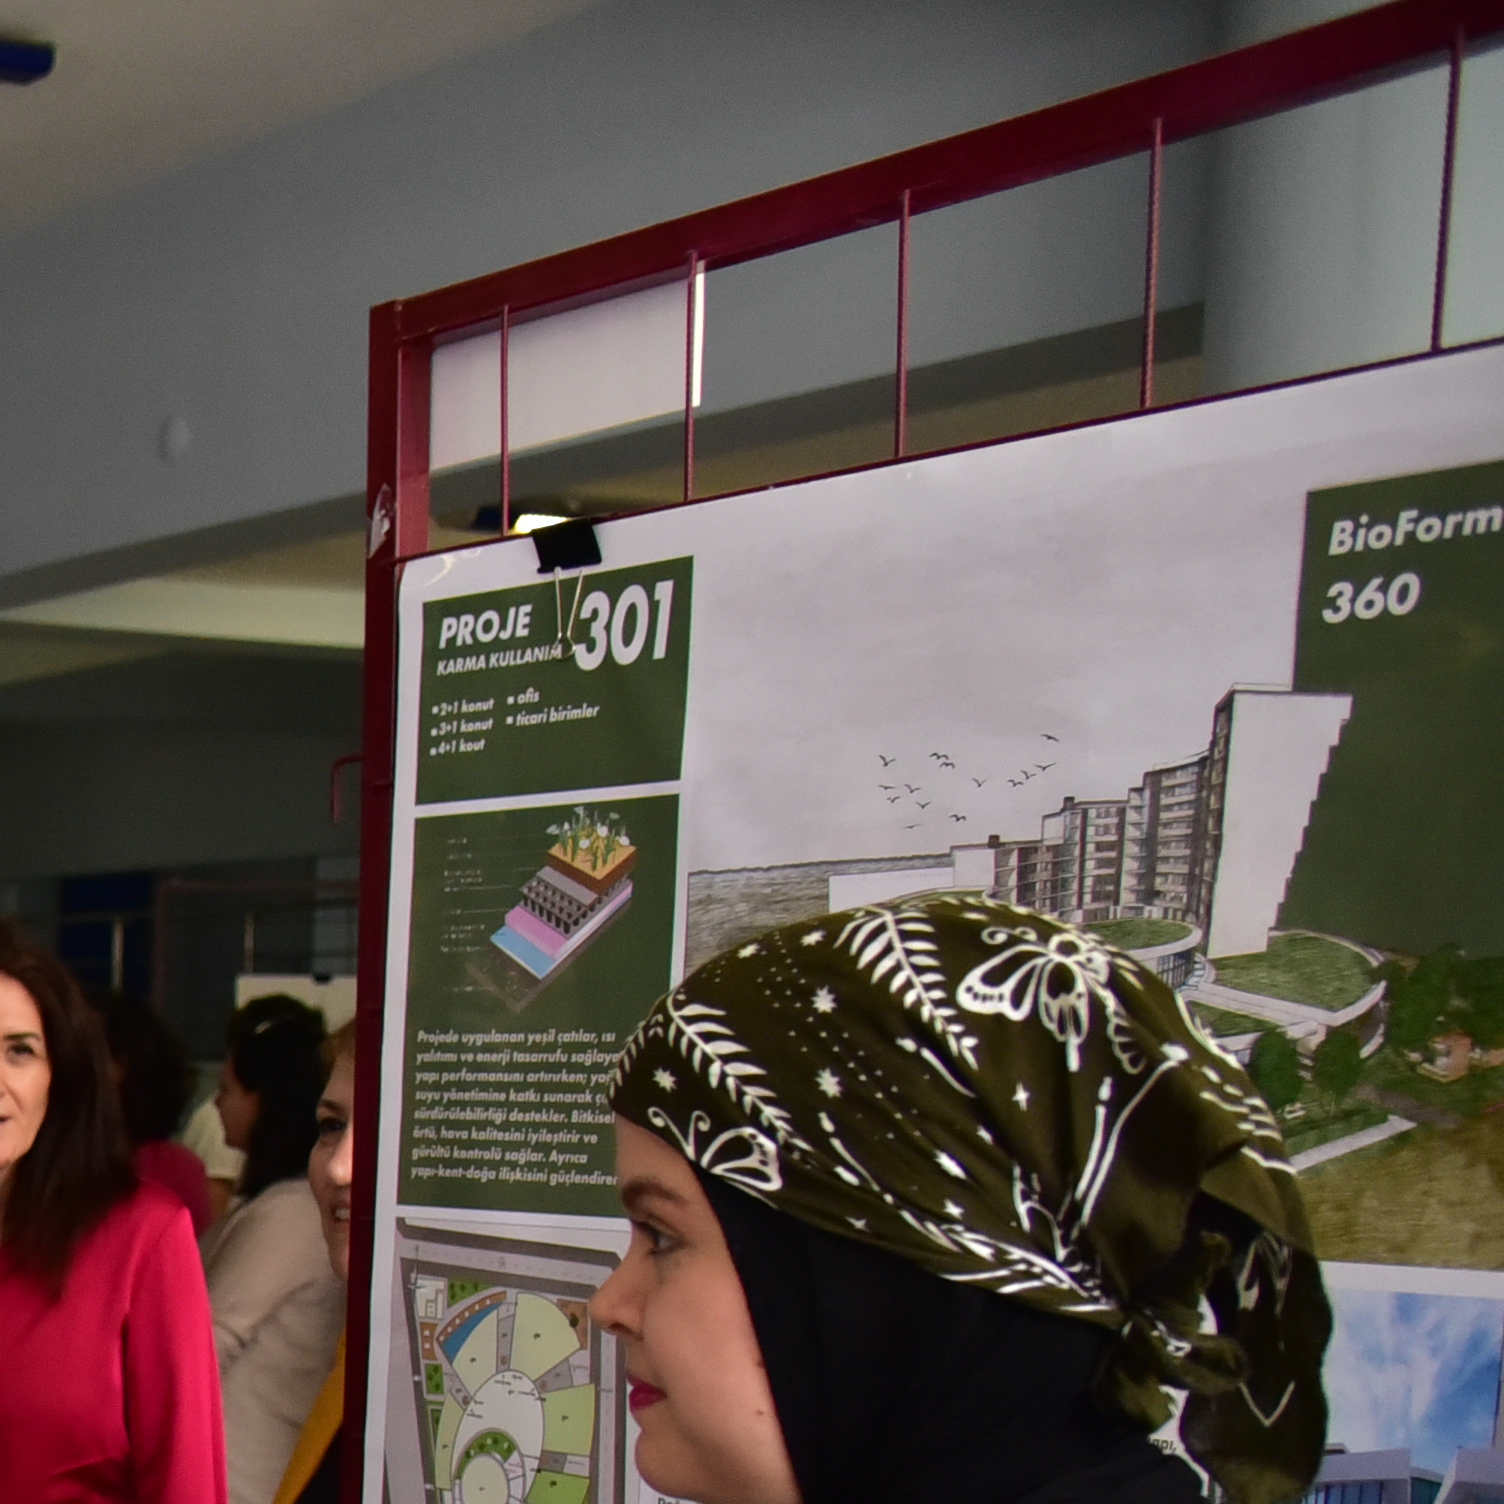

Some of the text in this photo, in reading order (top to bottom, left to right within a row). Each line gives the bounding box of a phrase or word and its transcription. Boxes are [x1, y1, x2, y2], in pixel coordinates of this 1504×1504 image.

[1327, 505, 1503, 556] BioForm
[1321, 572, 1421, 624] 360
[438, 604, 533, 650] PROJE
[574, 579, 675, 672] 301
[436, 644, 563, 676] KARMA KULLANIM
[460, 698, 495, 714] konut
[516, 687, 540, 705] ofis
[515, 702, 600, 727] ticari birimler
[459, 717, 494, 733] konut
[458, 737, 486, 753] kout
[417, 1030, 460, 1046] Projede
[461, 1029, 525, 1047] uygulanan
[527, 1028, 555, 1046] yeşil
[557, 1028, 599, 1046] çatılar,
[416, 1049, 458, 1065] yalıtımı
[460, 1052, 474, 1062] ve
[476, 1050, 511, 1066] enerji
[513, 1048, 568, 1063] tasarrufu
[415, 1067, 588, 1085] yapı performansını artırırken;
[415, 1091, 441, 1104] suyu
[442, 1089, 507, 1104] yönetimine
[508, 1088, 541, 1102] katkı
[543, 1089, 593, 1103] sunarak
[414, 1105, 615, 1125] sürdürülebilirliği destekler. Bitkisel
[412, 1126, 599, 1146] örtü, hava kalitesini iyileştirir ve
[411, 1144, 589, 1166] gürültü kontrolü sağlar. Ayrıca
[410, 1164, 497, 1183] yapı-kent-doğa
[498, 1165, 548, 1184] ilişkisini
